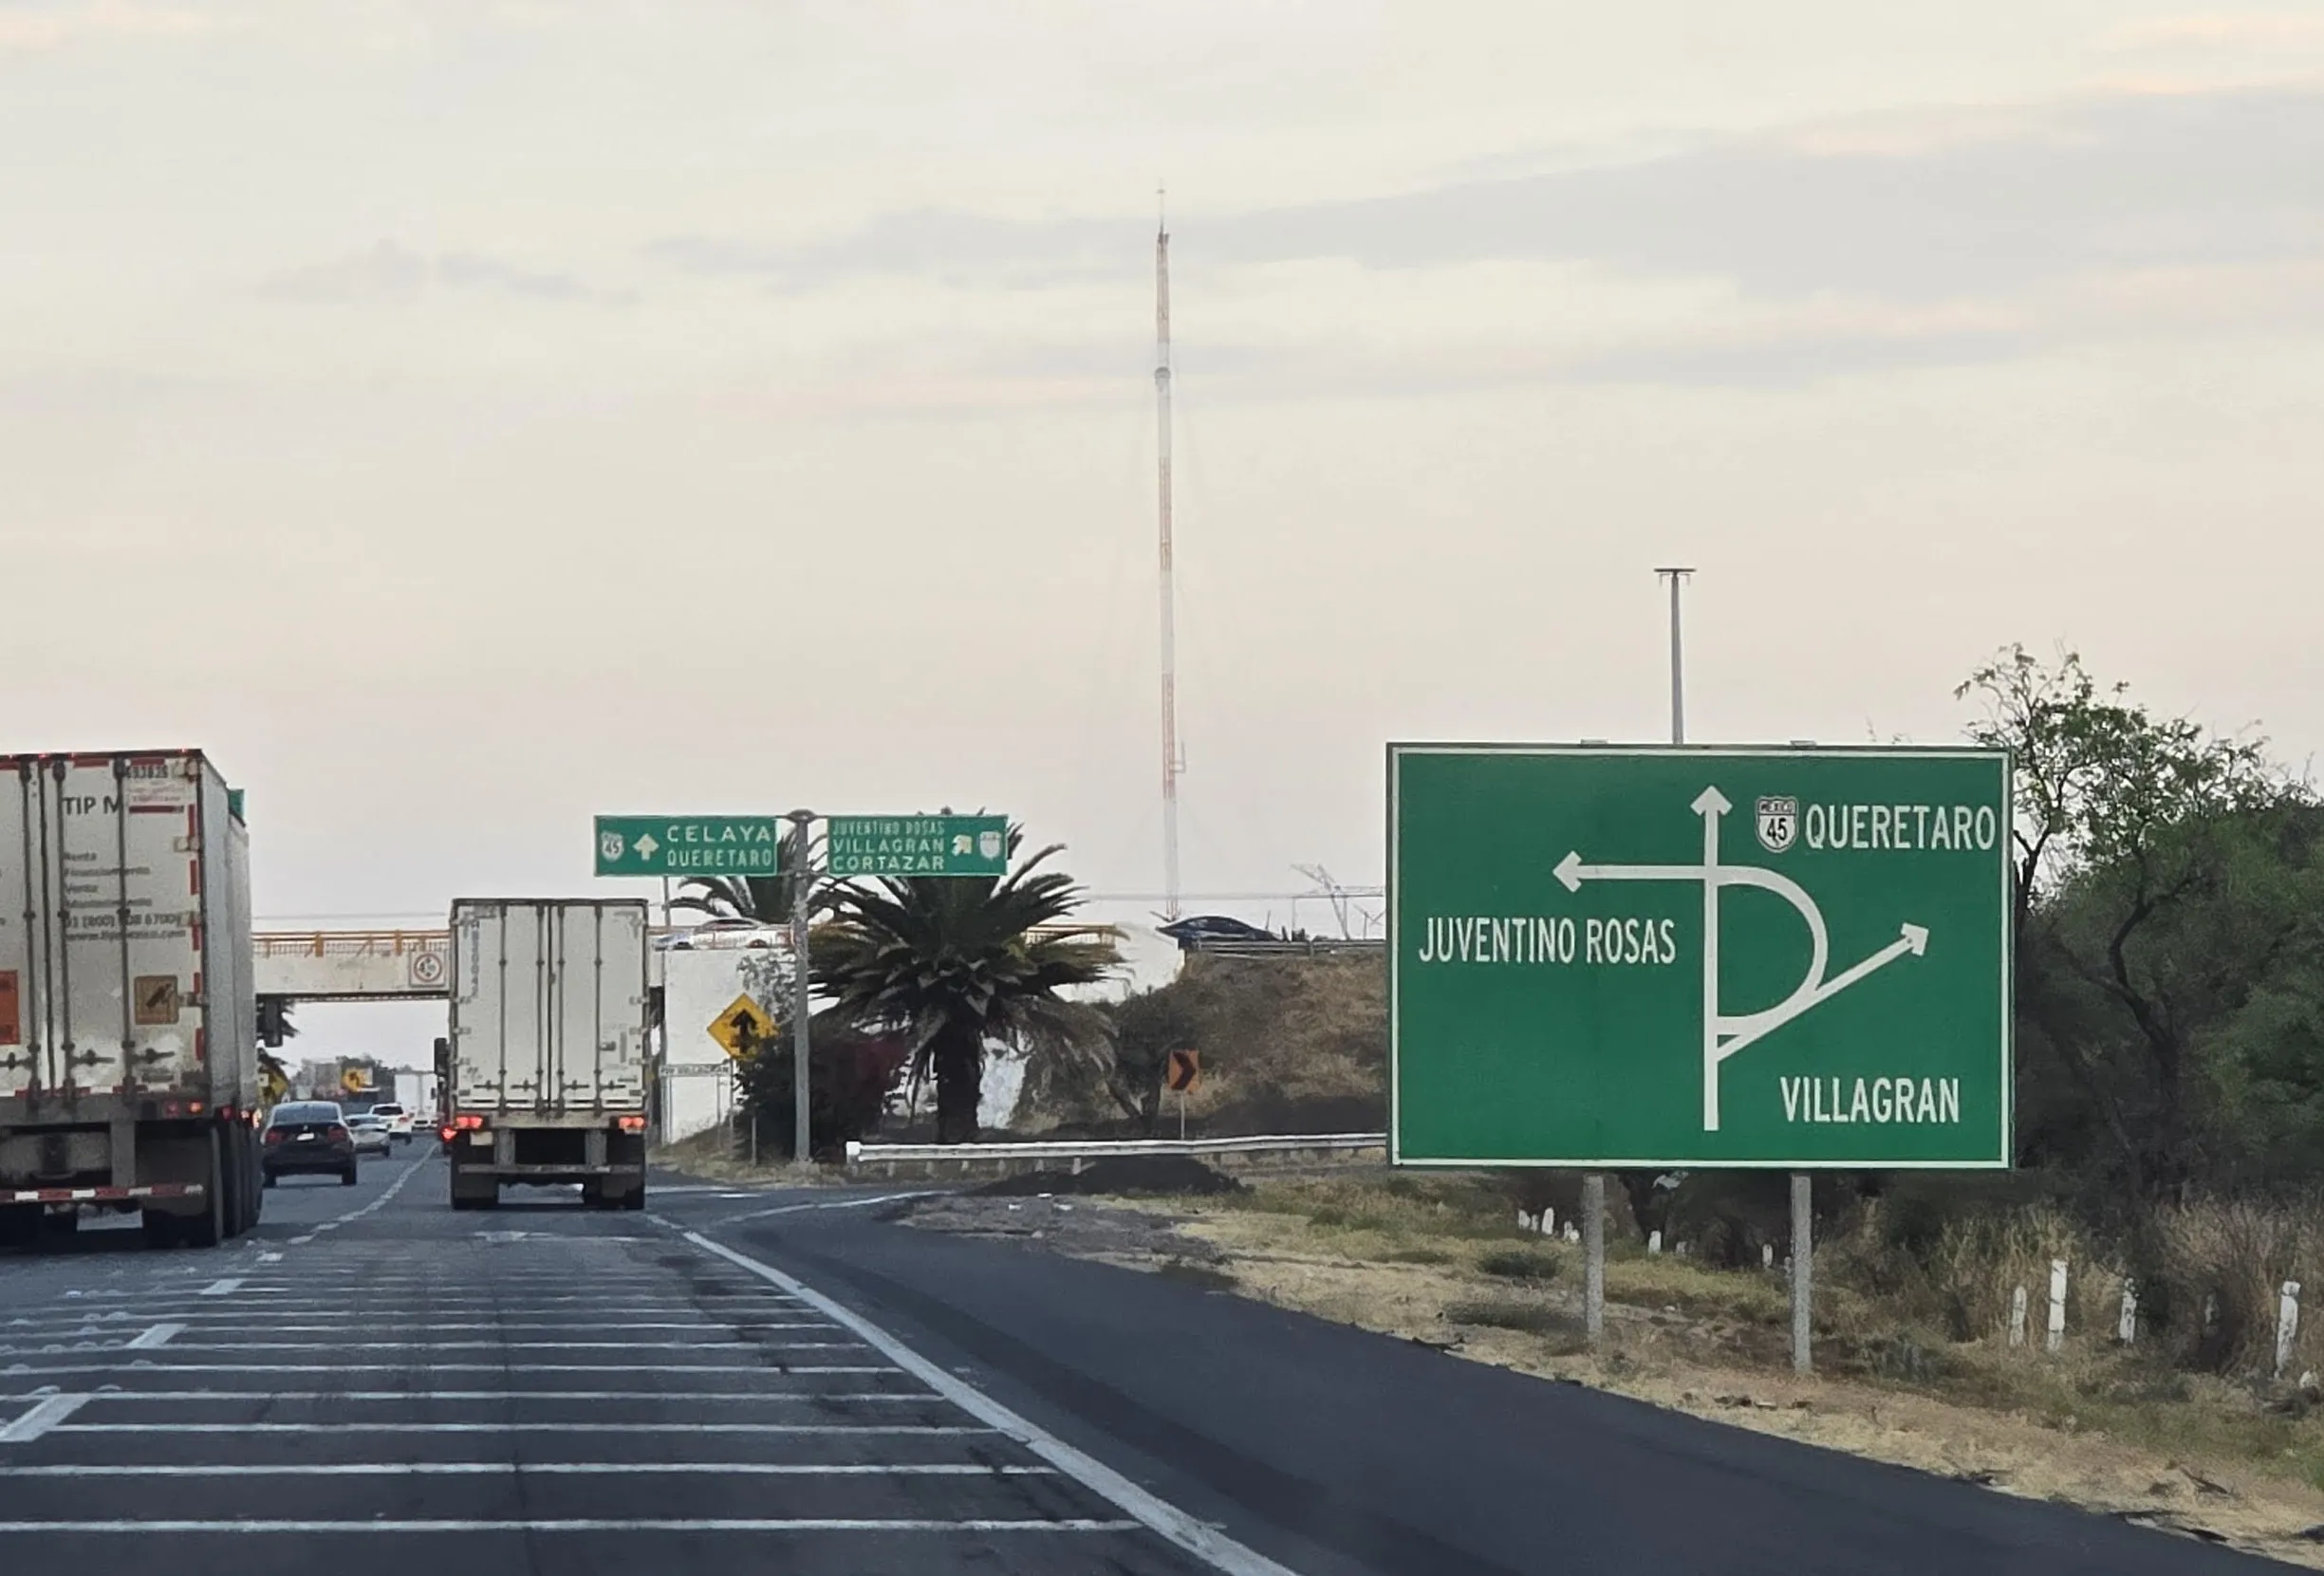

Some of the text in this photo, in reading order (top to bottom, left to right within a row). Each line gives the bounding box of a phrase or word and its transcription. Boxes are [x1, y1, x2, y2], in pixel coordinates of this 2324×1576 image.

[63, 796, 97, 815] TIP
[666, 825, 772, 843] CELAYA
[1767, 817, 1788, 841] 45
[1806, 804, 1996, 849] QUERETARO
[604, 839, 620, 855] 45
[832, 838, 945, 854] VILLAGRAN
[666, 848, 772, 867] QUERETARO
[832, 855, 945, 871] CORTAZAR
[1419, 917, 1676, 964] JUVENTINO ROSAS
[1780, 1077, 1960, 1123] VILLAGRAN
